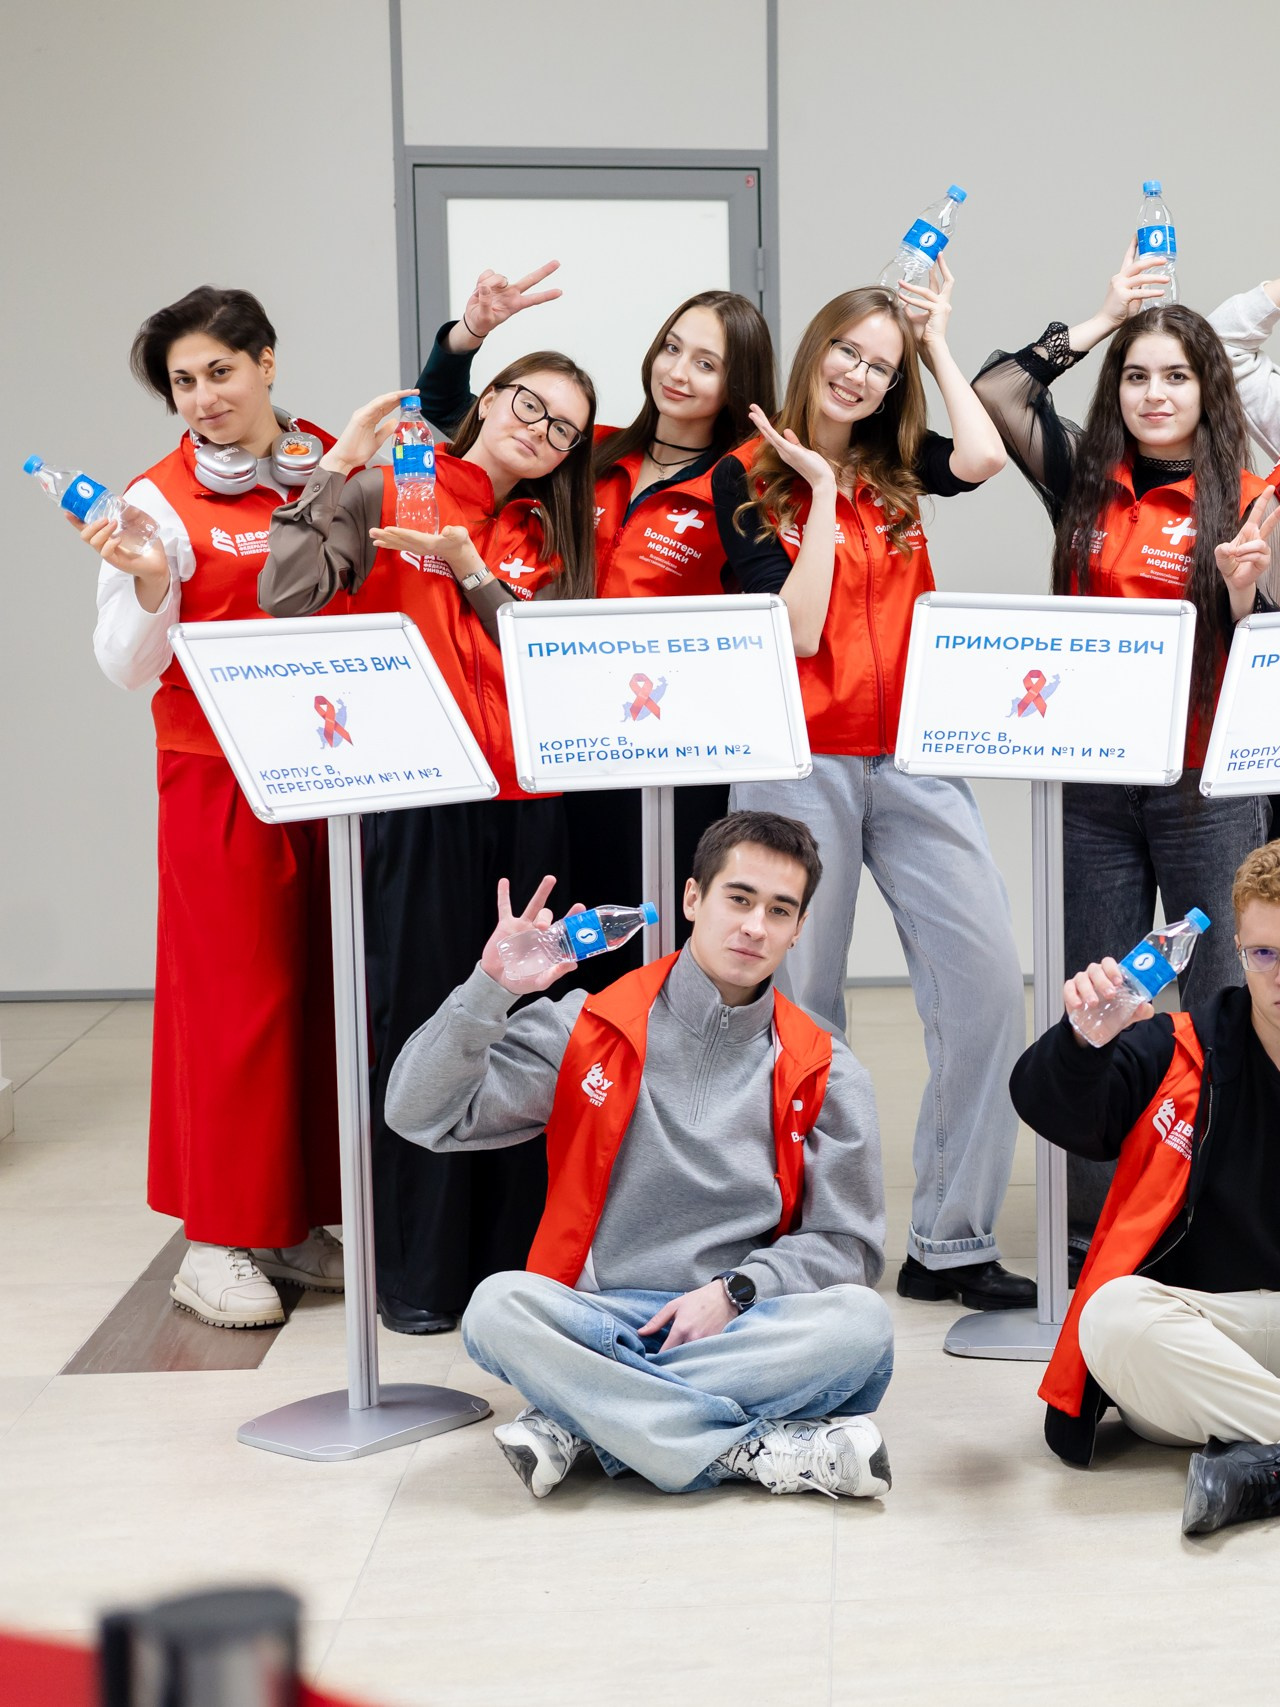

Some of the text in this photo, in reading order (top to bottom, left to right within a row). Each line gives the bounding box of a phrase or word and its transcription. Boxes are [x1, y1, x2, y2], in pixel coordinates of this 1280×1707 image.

[644, 527, 701, 559] Волонтеры
[647, 541, 688, 564] медики
[1146, 557, 1188, 573] медики
[527, 635, 764, 658] ПРИМОРЬЕ БЕЗ ВИЧ
[935, 635, 1164, 655] ПРИМОРЬЕ БЕЗ ВИЧ
[209, 655, 412, 683] ПРИМОРЬЕ БЕЗ ВИЧ
[538, 736, 634, 752] КОРПУС В,
[923, 730, 1012, 743] КОРПУС В,
[541, 744, 752, 765] ПЕРЕГОВОРКИ №1 И №2
[922, 743, 1126, 758] ПЕРЕГОВОРКИ №1 И №2
[259, 764, 340, 782] КОРПУС В,
[266, 767, 443, 795] ПЕРЕГОВОРКИ №1 И №2
[1173, 1119, 1194, 1137] ДВ
